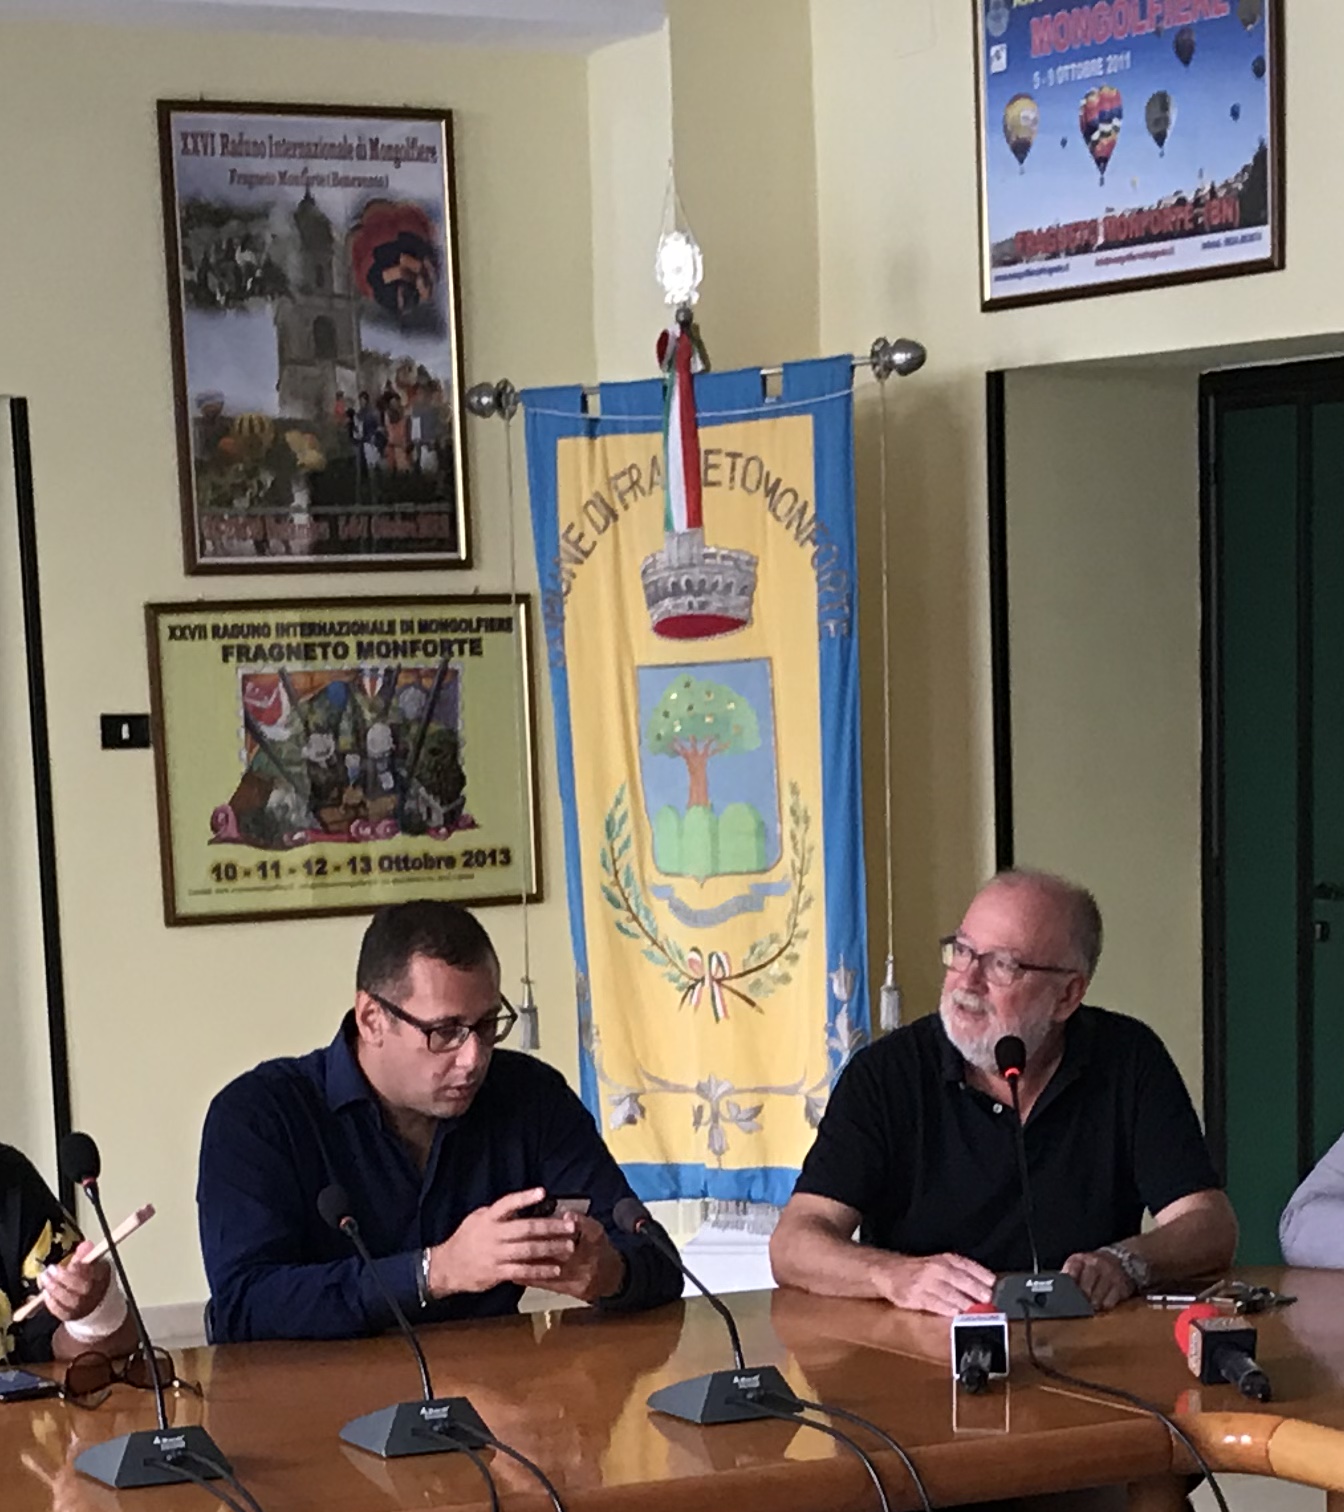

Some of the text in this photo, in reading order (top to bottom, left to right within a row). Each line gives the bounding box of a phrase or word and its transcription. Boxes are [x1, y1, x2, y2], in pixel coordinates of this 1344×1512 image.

[180, 131, 215, 157] XXVI
[219, 131, 267, 159] Raduno
[268, 134, 354, 160] Internazionale
[368, 136, 438, 168] Mongolfiere
[611, 448, 765, 512] FRAETO
[168, 615, 513, 641] XXVII RADUNO INTERNAZIONALE DI MONGOLFIERE
[221, 637, 484, 664] FRAGNETO MONFORTE
[211, 862, 238, 882] 10
[256, 859, 282, 879] 11
[306, 857, 328, 877] 12
[346, 855, 372, 875] 13
[378, 851, 456, 873] Ottobre
[461, 848, 513, 868] 2013
